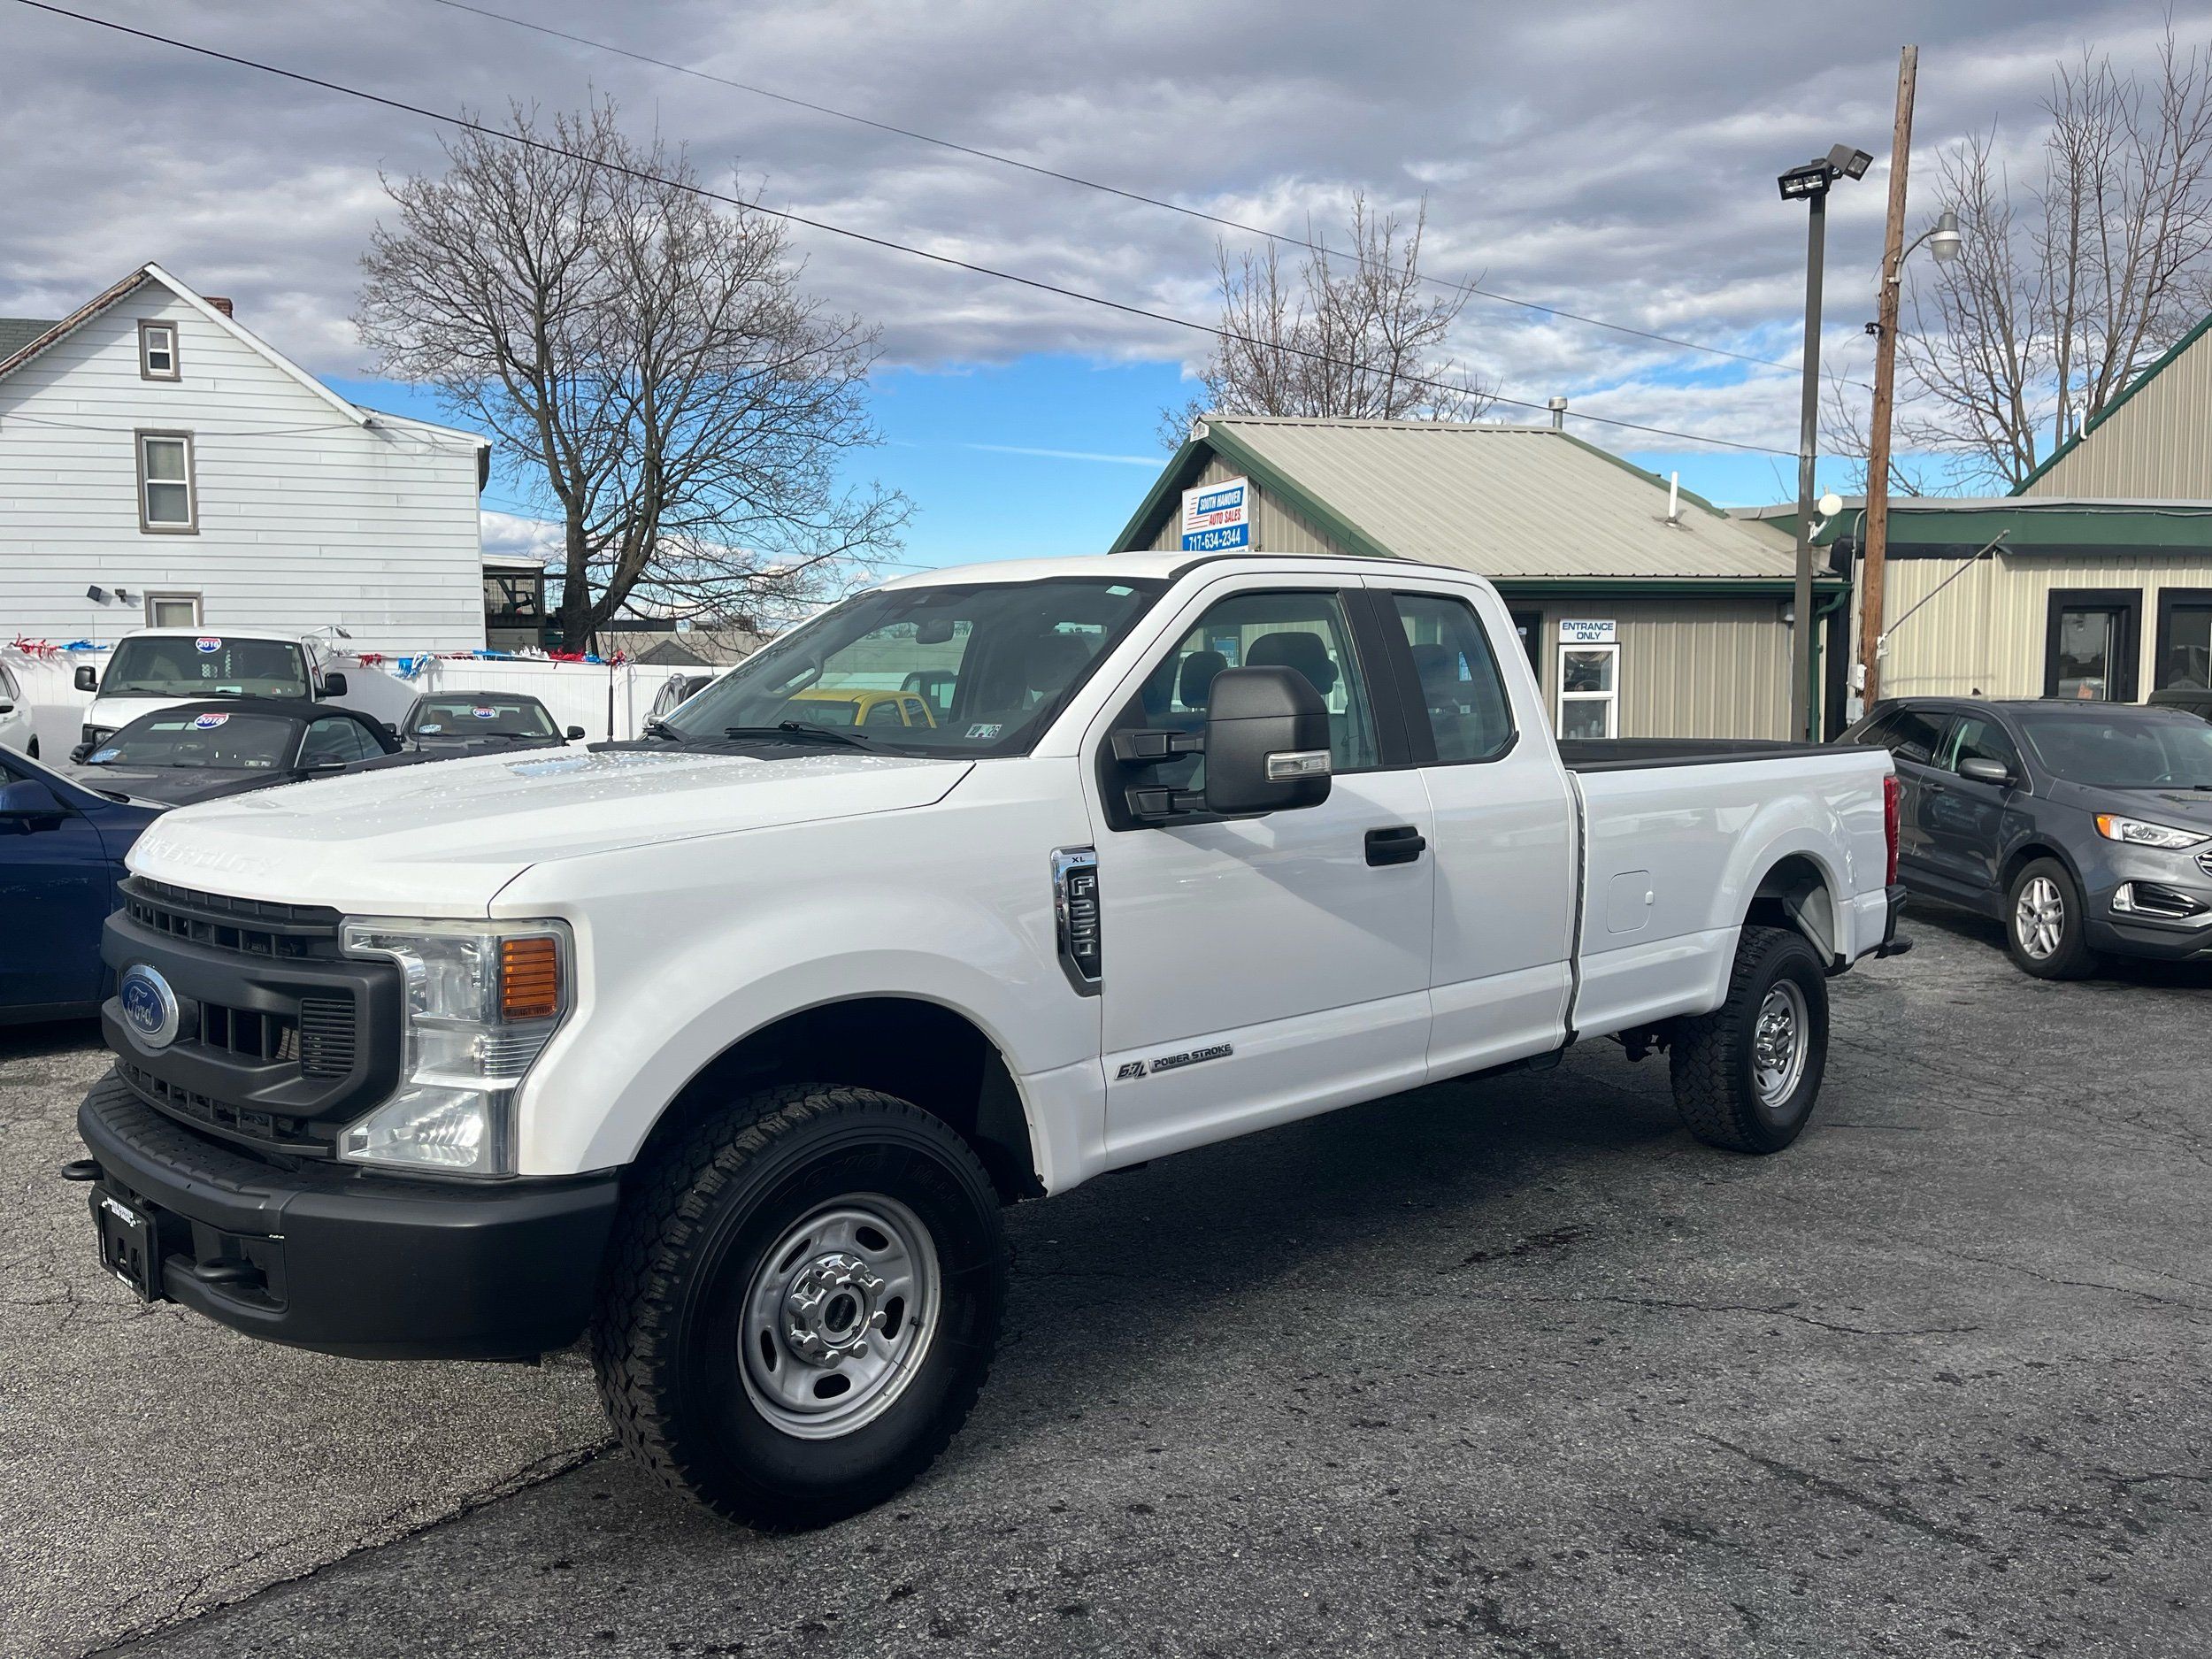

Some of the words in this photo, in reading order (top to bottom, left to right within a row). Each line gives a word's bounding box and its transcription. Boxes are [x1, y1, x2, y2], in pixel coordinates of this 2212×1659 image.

[1200, 496, 1216, 511] SOUTH
[1217, 490, 1240, 507] HANOVER
[1209, 512, 1223, 526] AUTO
[1225, 508, 1241, 523] SALES
[1188, 528, 1240, 551] 717-634-2344
[1562, 622, 1614, 631] ENTRANCE
[128, 986, 154, 1026] Ford
[1153, 1053, 1190, 1069] POWER
[1191, 1043, 1232, 1060] STROKE
